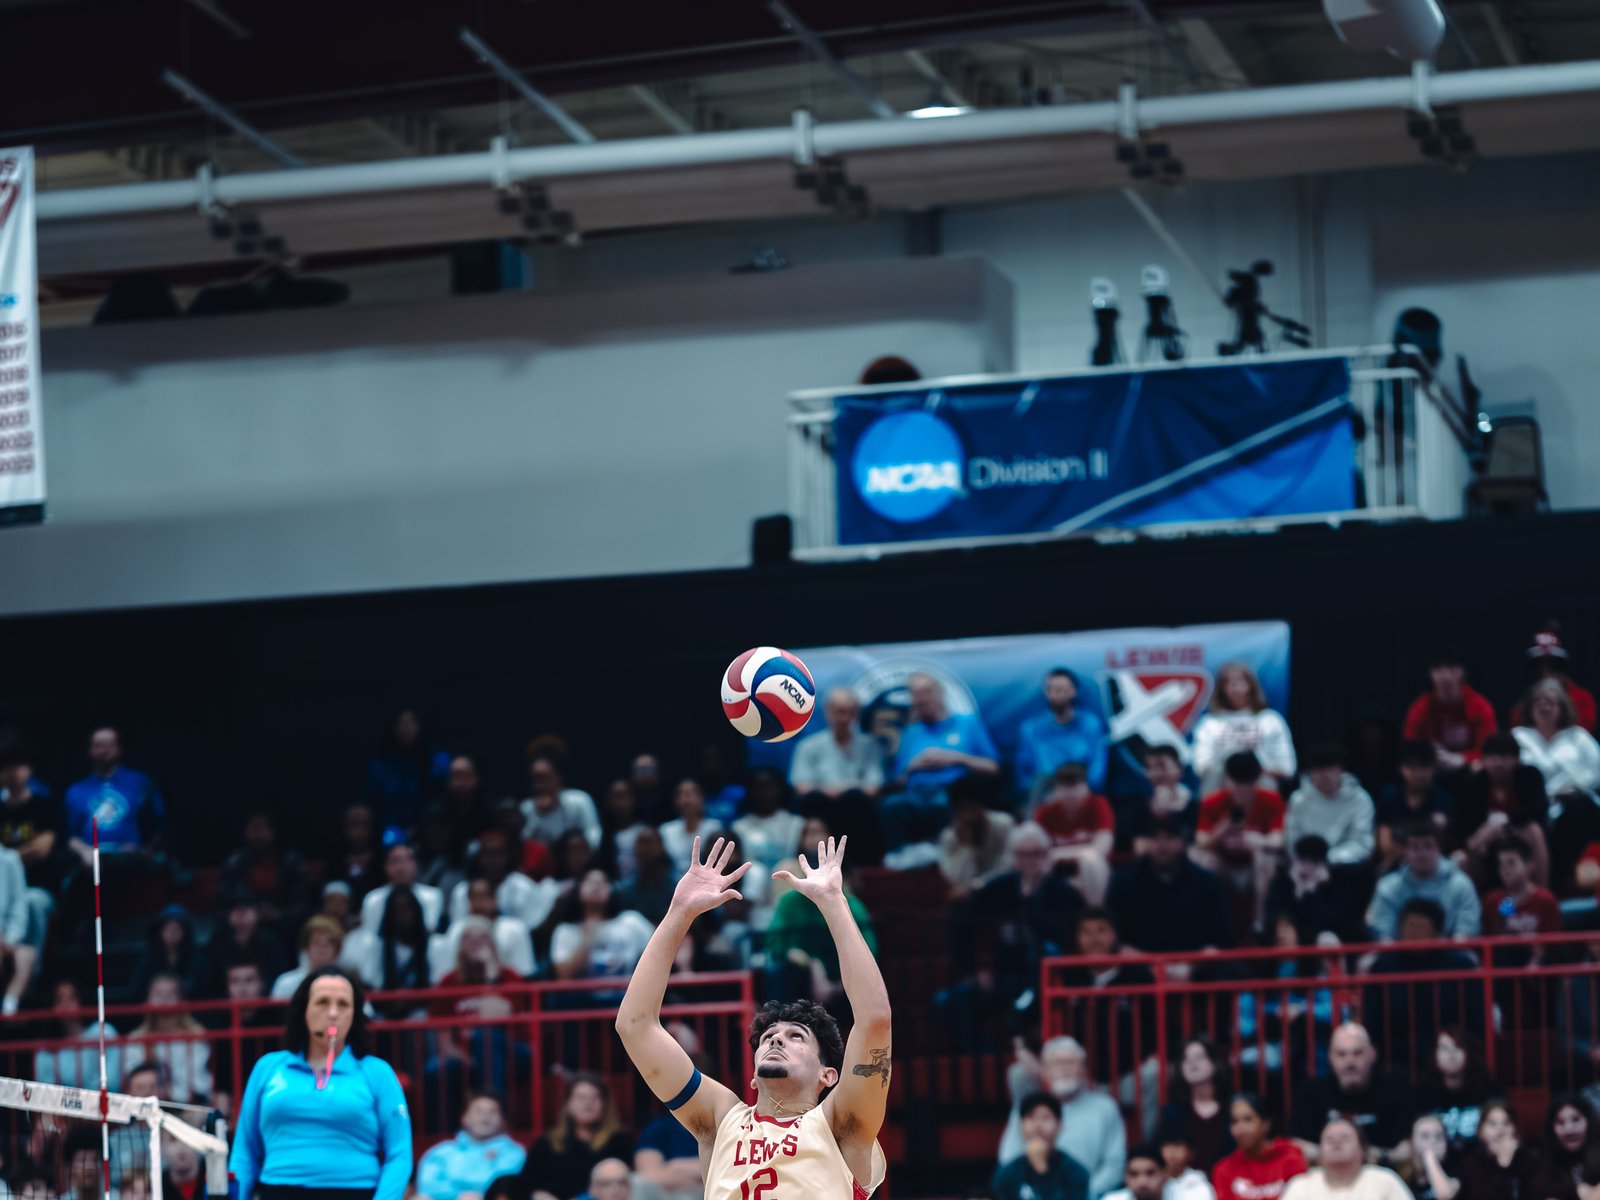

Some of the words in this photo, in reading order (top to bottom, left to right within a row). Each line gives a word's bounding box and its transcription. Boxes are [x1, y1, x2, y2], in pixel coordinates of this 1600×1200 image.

[866, 461, 962, 492] NCAA
[968, 455, 1086, 490] Division
[1105, 643, 1205, 669] LEWIS
[780, 678, 806, 709] NCAA
[733, 1133, 798, 1167] LEWS
